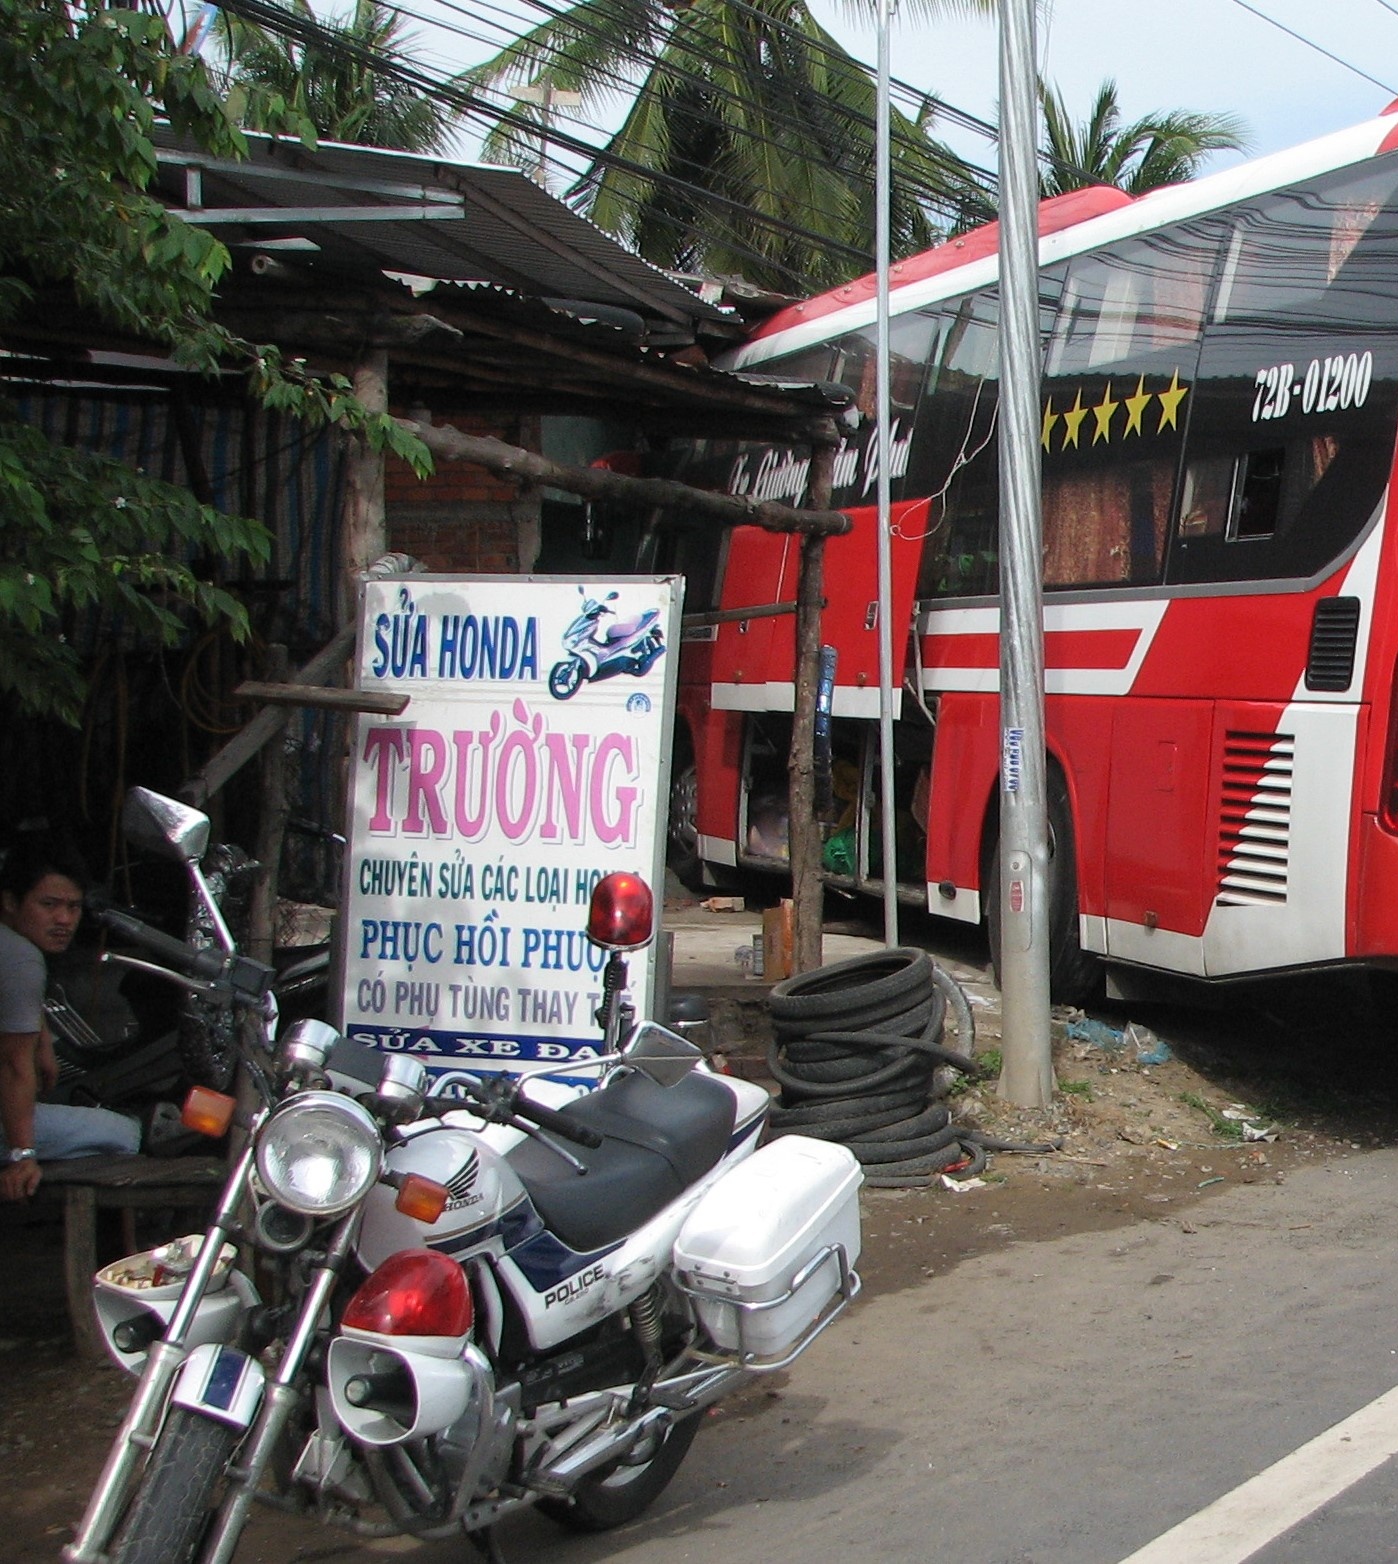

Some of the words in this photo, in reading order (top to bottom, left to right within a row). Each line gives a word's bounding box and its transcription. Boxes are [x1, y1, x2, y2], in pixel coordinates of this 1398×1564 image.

[1252, 351, 1373, 422] 72B-01200
[372, 587, 429, 678] SỬA
[438, 614, 539, 680] HONDA
[363, 697, 639, 845] TRƯỜNG
[360, 851, 433, 898] CHUYÊN
[438, 849, 475, 899] SỬA
[481, 855, 519, 902] CÁC
[525, 867, 569, 913] LOẠI
[361, 919, 443, 972] PHỤC
[454, 909, 511, 967] HỒI
[357, 971, 387, 1013] CÓ
[395, 981, 440, 1025] PHỤ
[449, 976, 510, 1021] TÙNG
[518, 988, 579, 1025] THAY
[353, 1028, 442, 1052] SỬA
[455, 1038, 521, 1056] XE
[445, 1192, 484, 1211] HONDA
[545, 1263, 604, 1309] POLICE
